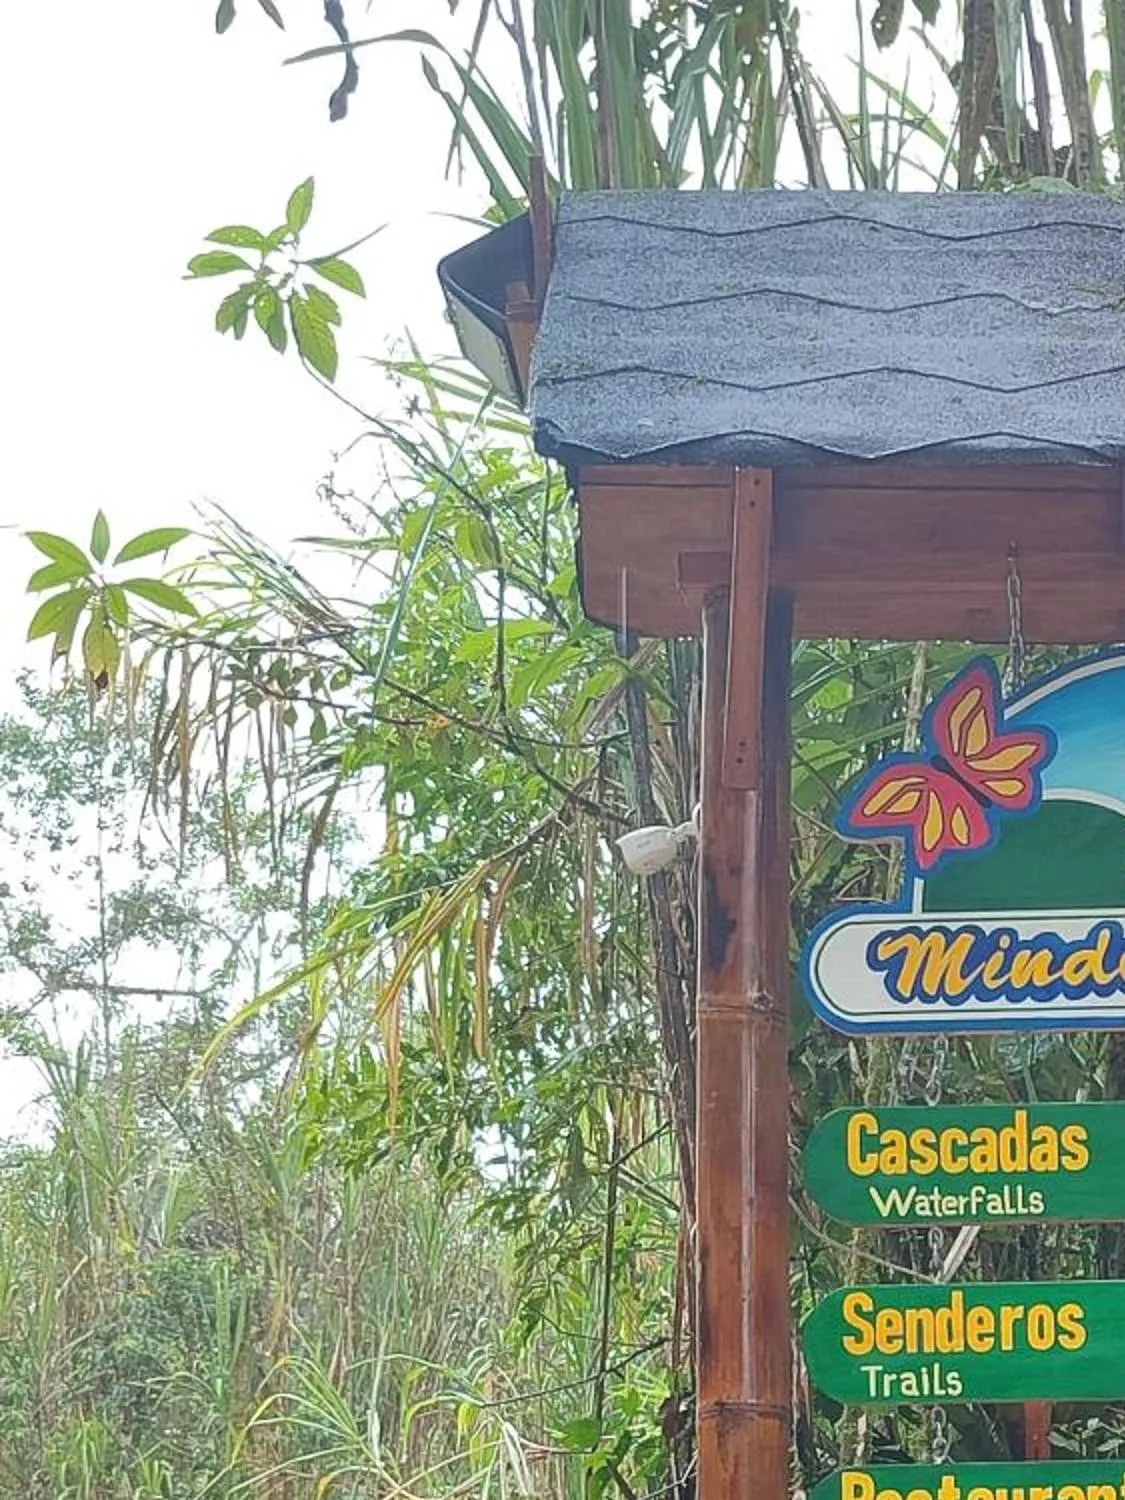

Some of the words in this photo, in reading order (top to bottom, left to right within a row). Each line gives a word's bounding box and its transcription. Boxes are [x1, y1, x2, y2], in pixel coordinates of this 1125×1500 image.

[847, 1109, 1089, 1177] Cascadas
[869, 1186, 1045, 1216] Waterfalls
[842, 1290, 1086, 1356] Senderos
[861, 1365, 963, 1398] Trails
